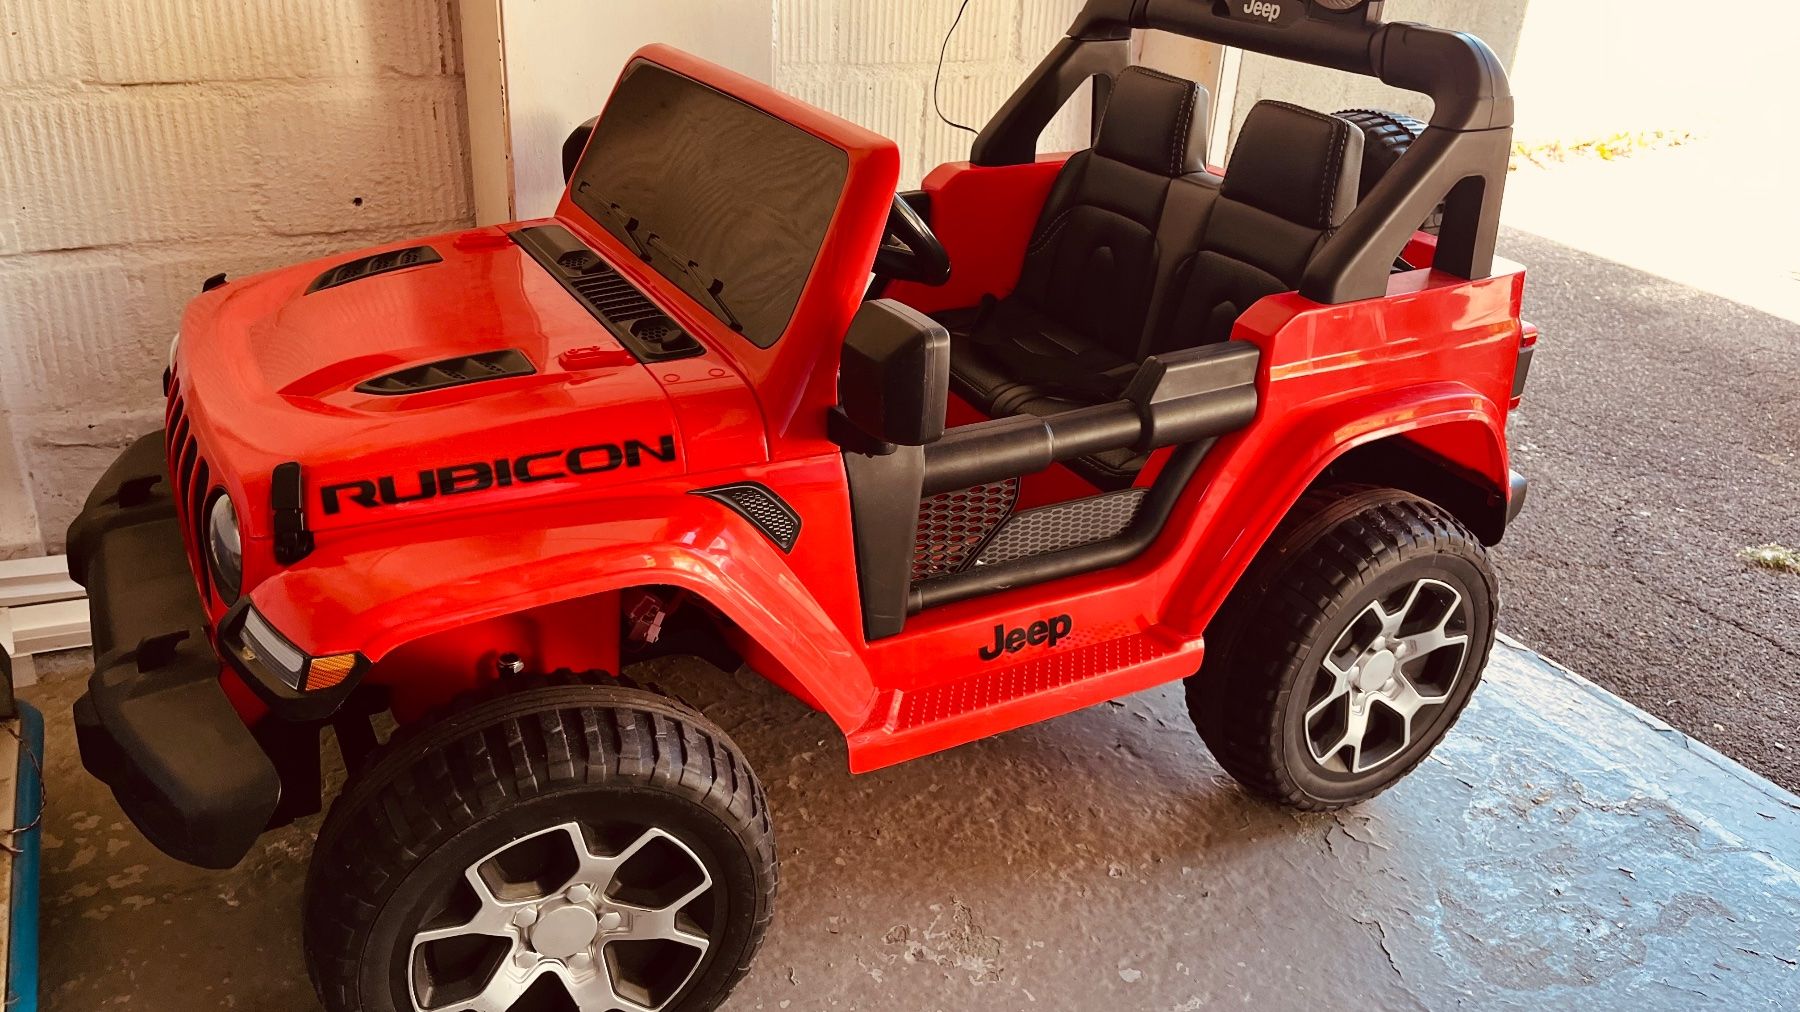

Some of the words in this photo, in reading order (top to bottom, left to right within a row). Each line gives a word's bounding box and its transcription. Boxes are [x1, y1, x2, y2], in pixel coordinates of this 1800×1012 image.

[1243, 0, 1281, 22] Jeep
[320, 434, 676, 515] RUBICON
[978, 613, 1072, 661] Jeep
